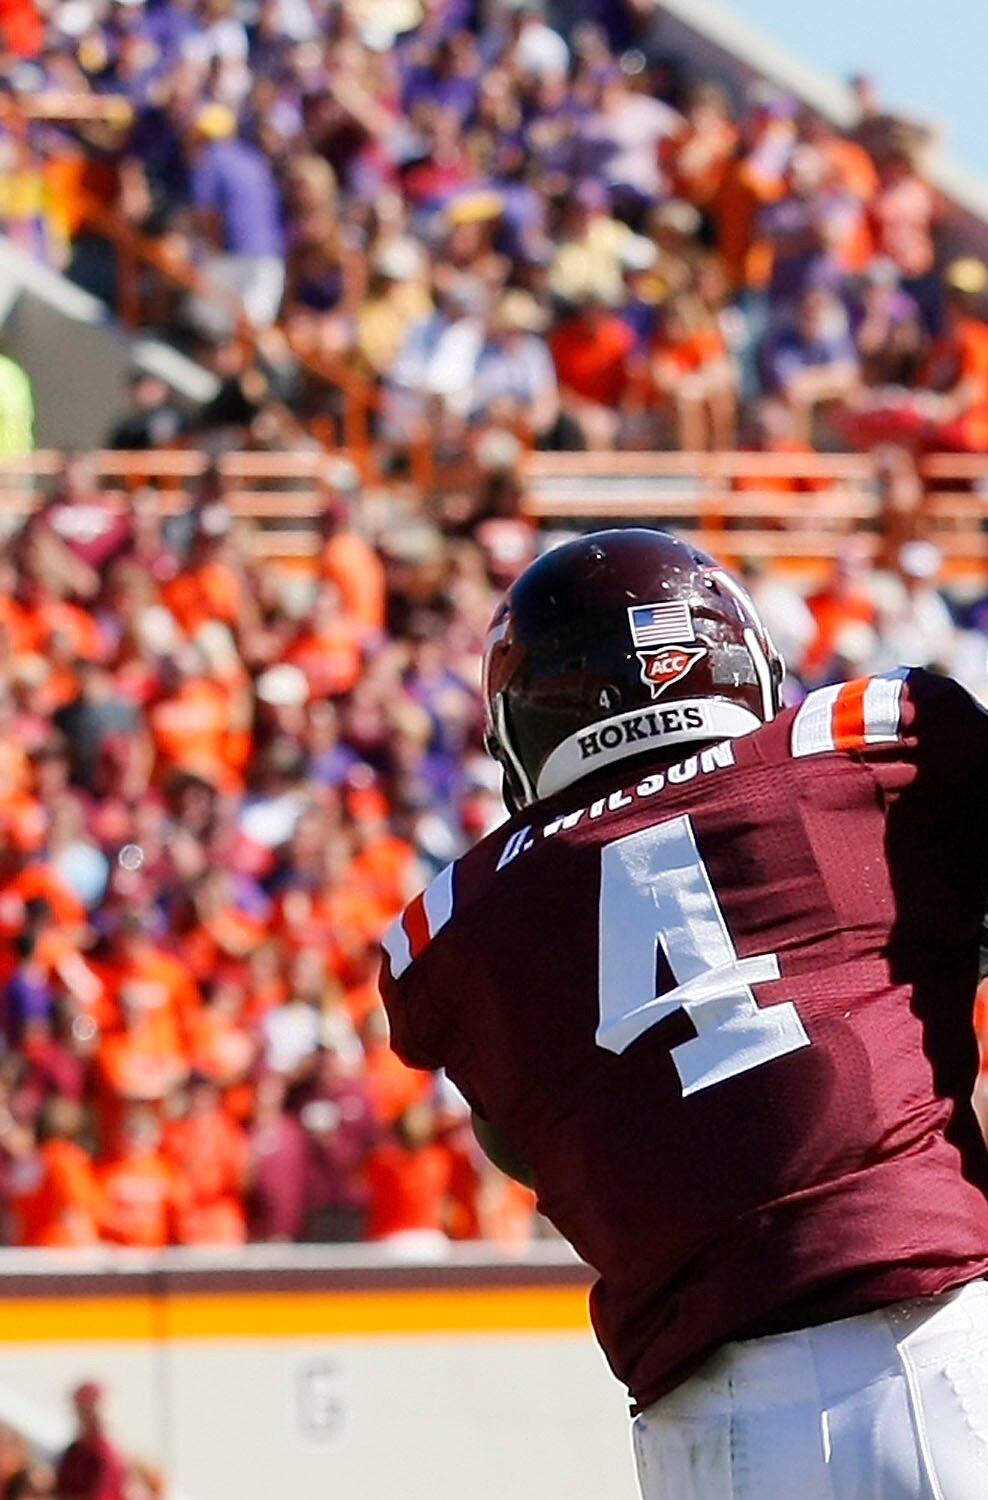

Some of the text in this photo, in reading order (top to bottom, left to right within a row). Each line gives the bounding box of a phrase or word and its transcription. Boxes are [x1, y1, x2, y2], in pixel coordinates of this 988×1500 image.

[649, 656, 686, 676] ACC
[599, 689, 611, 709] 4
[578, 707, 704, 759] HOKIES
[596, 813, 811, 1098] 4
